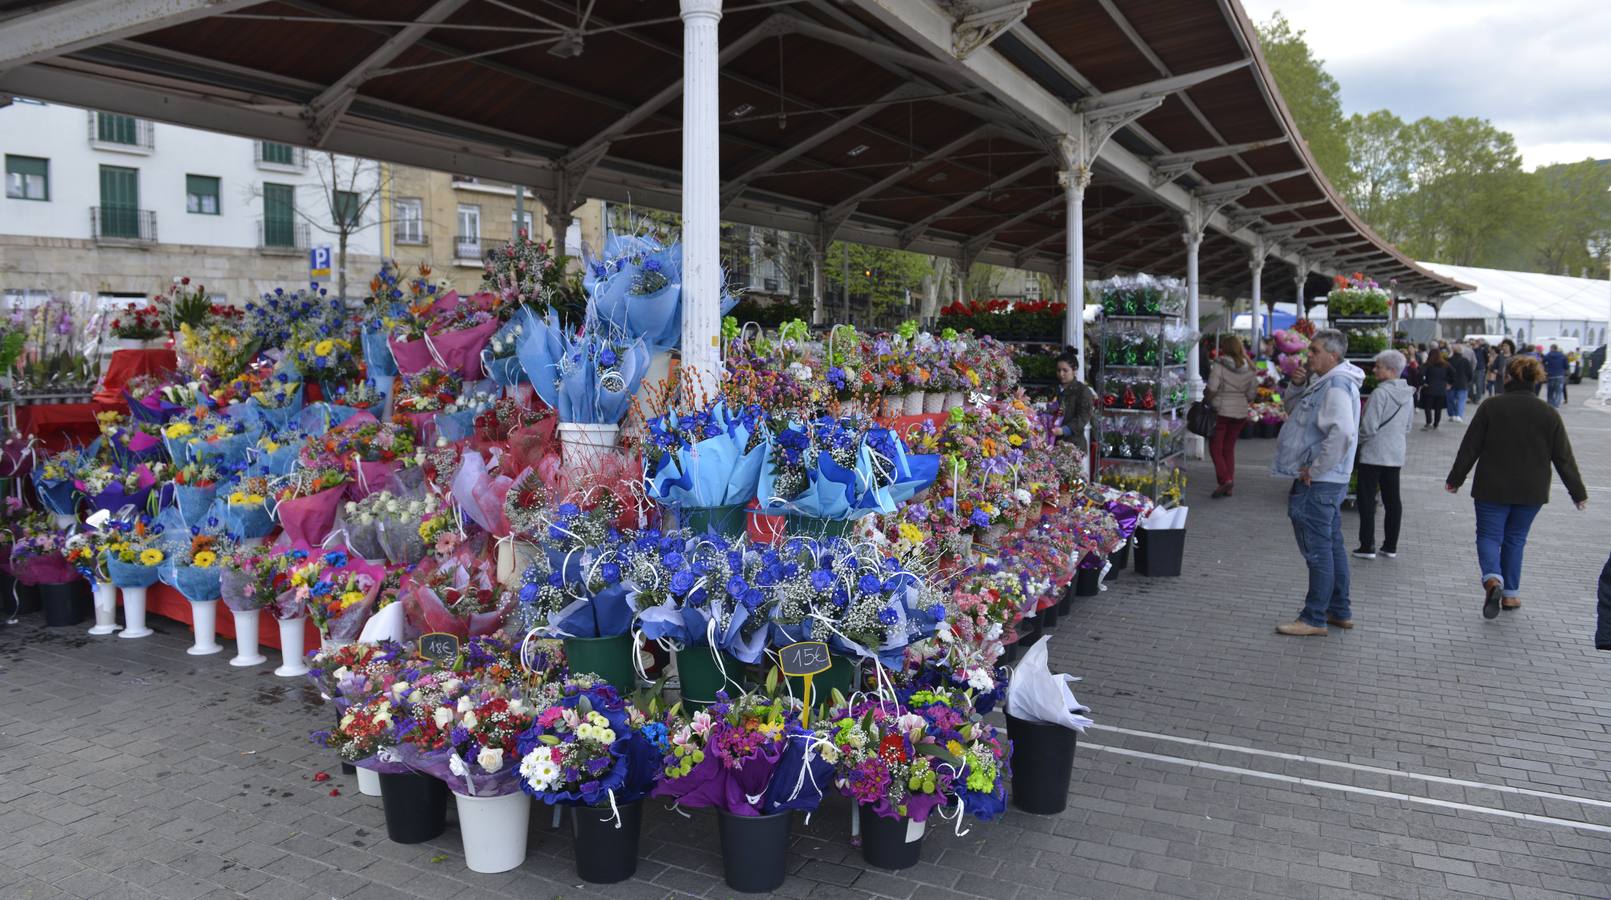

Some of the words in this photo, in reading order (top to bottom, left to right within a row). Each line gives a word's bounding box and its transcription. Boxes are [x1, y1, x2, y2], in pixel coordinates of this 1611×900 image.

[316, 248, 328, 269] P
[429, 641, 454, 654] 18€
[792, 646, 829, 667] 15€
